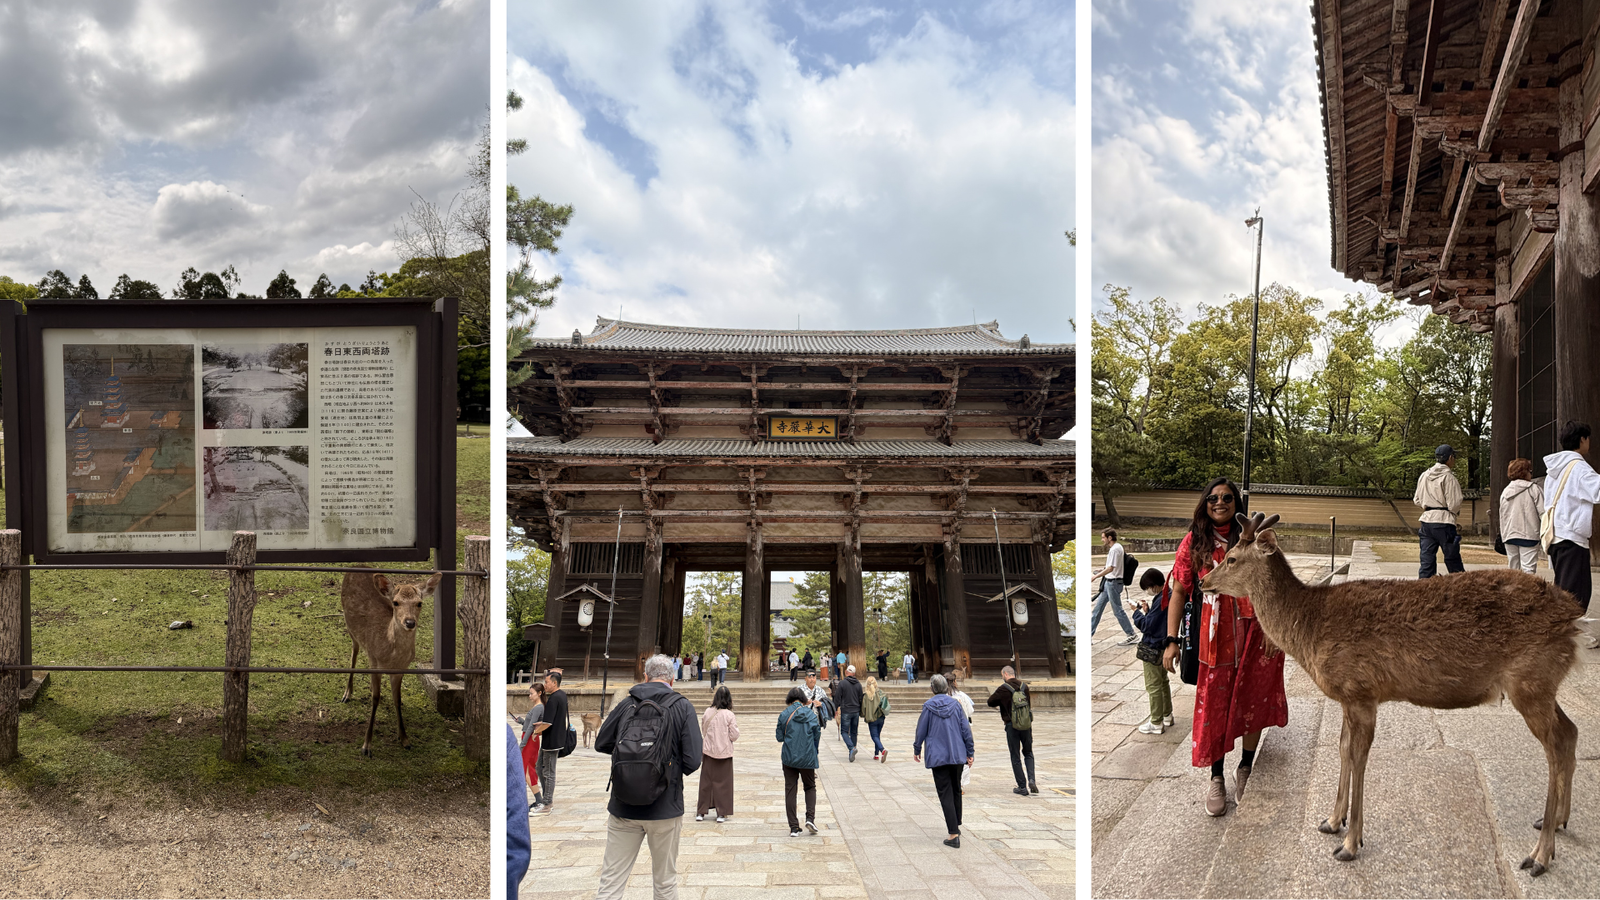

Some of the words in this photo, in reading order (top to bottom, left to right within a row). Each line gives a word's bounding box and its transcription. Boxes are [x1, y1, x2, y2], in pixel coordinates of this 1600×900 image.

[324, 346, 390, 356] 春日東西両塔跡
[342, 527, 394, 535] 奈良国立博物館
